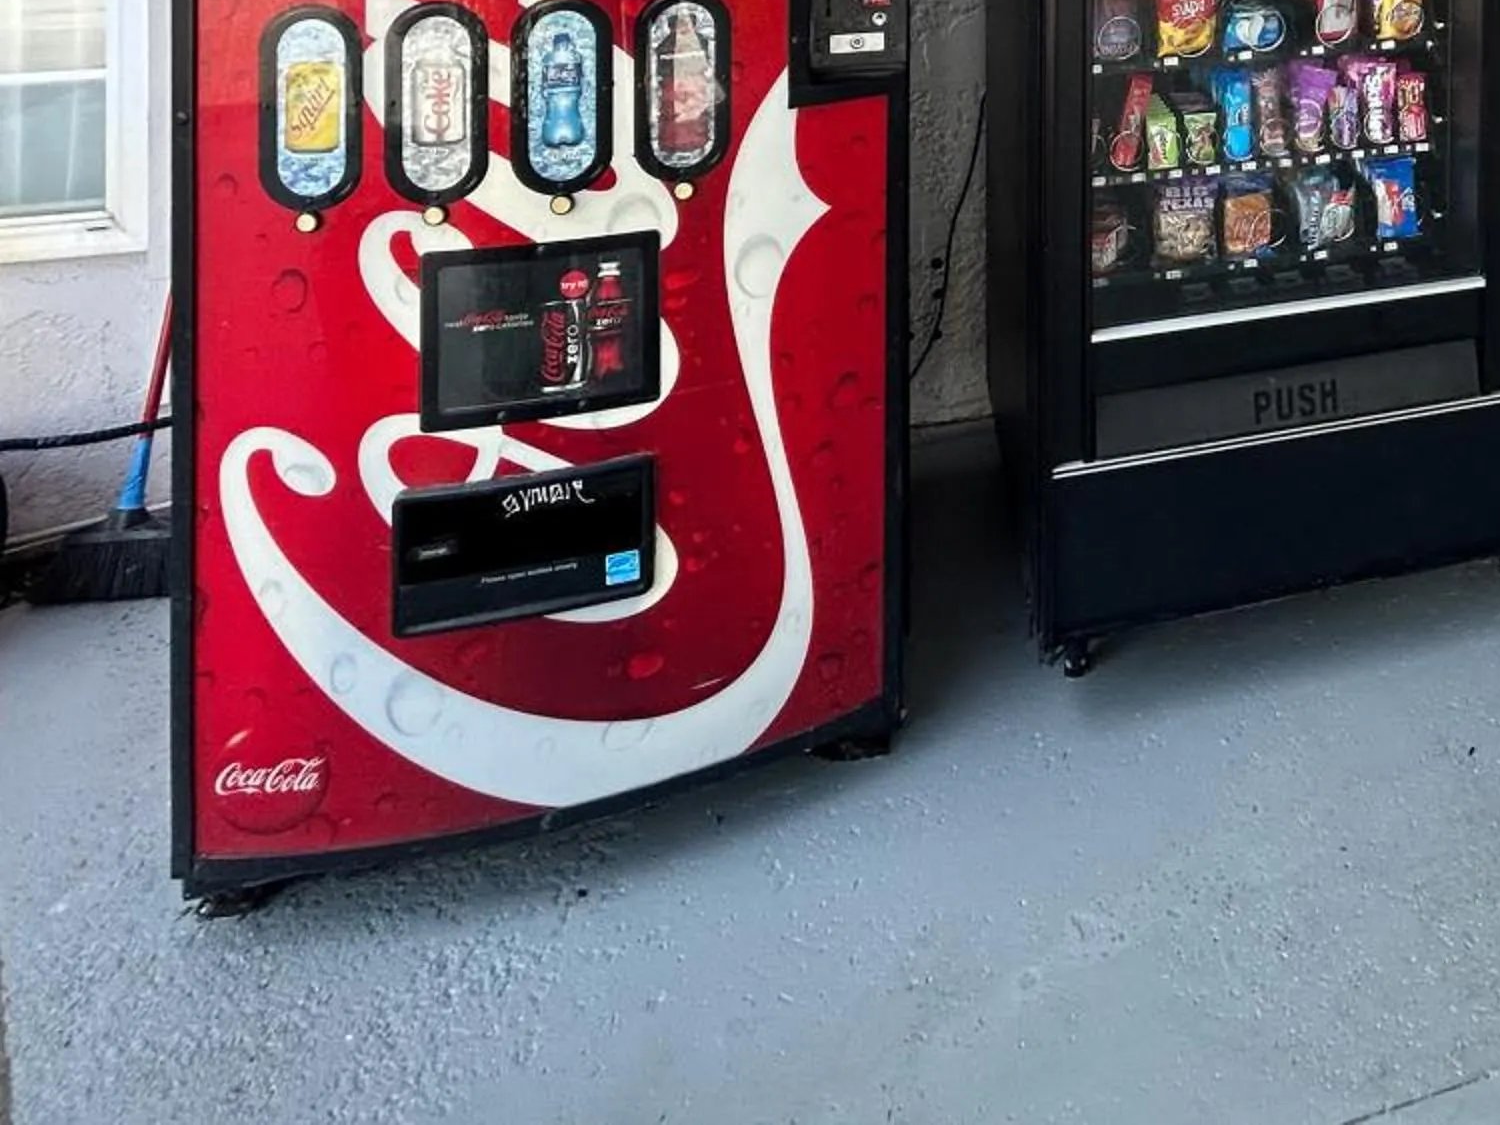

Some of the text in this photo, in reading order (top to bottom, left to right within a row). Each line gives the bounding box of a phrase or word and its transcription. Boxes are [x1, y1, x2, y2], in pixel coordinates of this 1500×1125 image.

[424, 71, 451, 142] Coke
[1159, 196, 1215, 212] TEXAS
[1165, 186, 1209, 198] BIG
[566, 324, 579, 364] zero
[1254, 379, 1337, 425] PUSH
[215, 757, 326, 796] Coca-Cola
